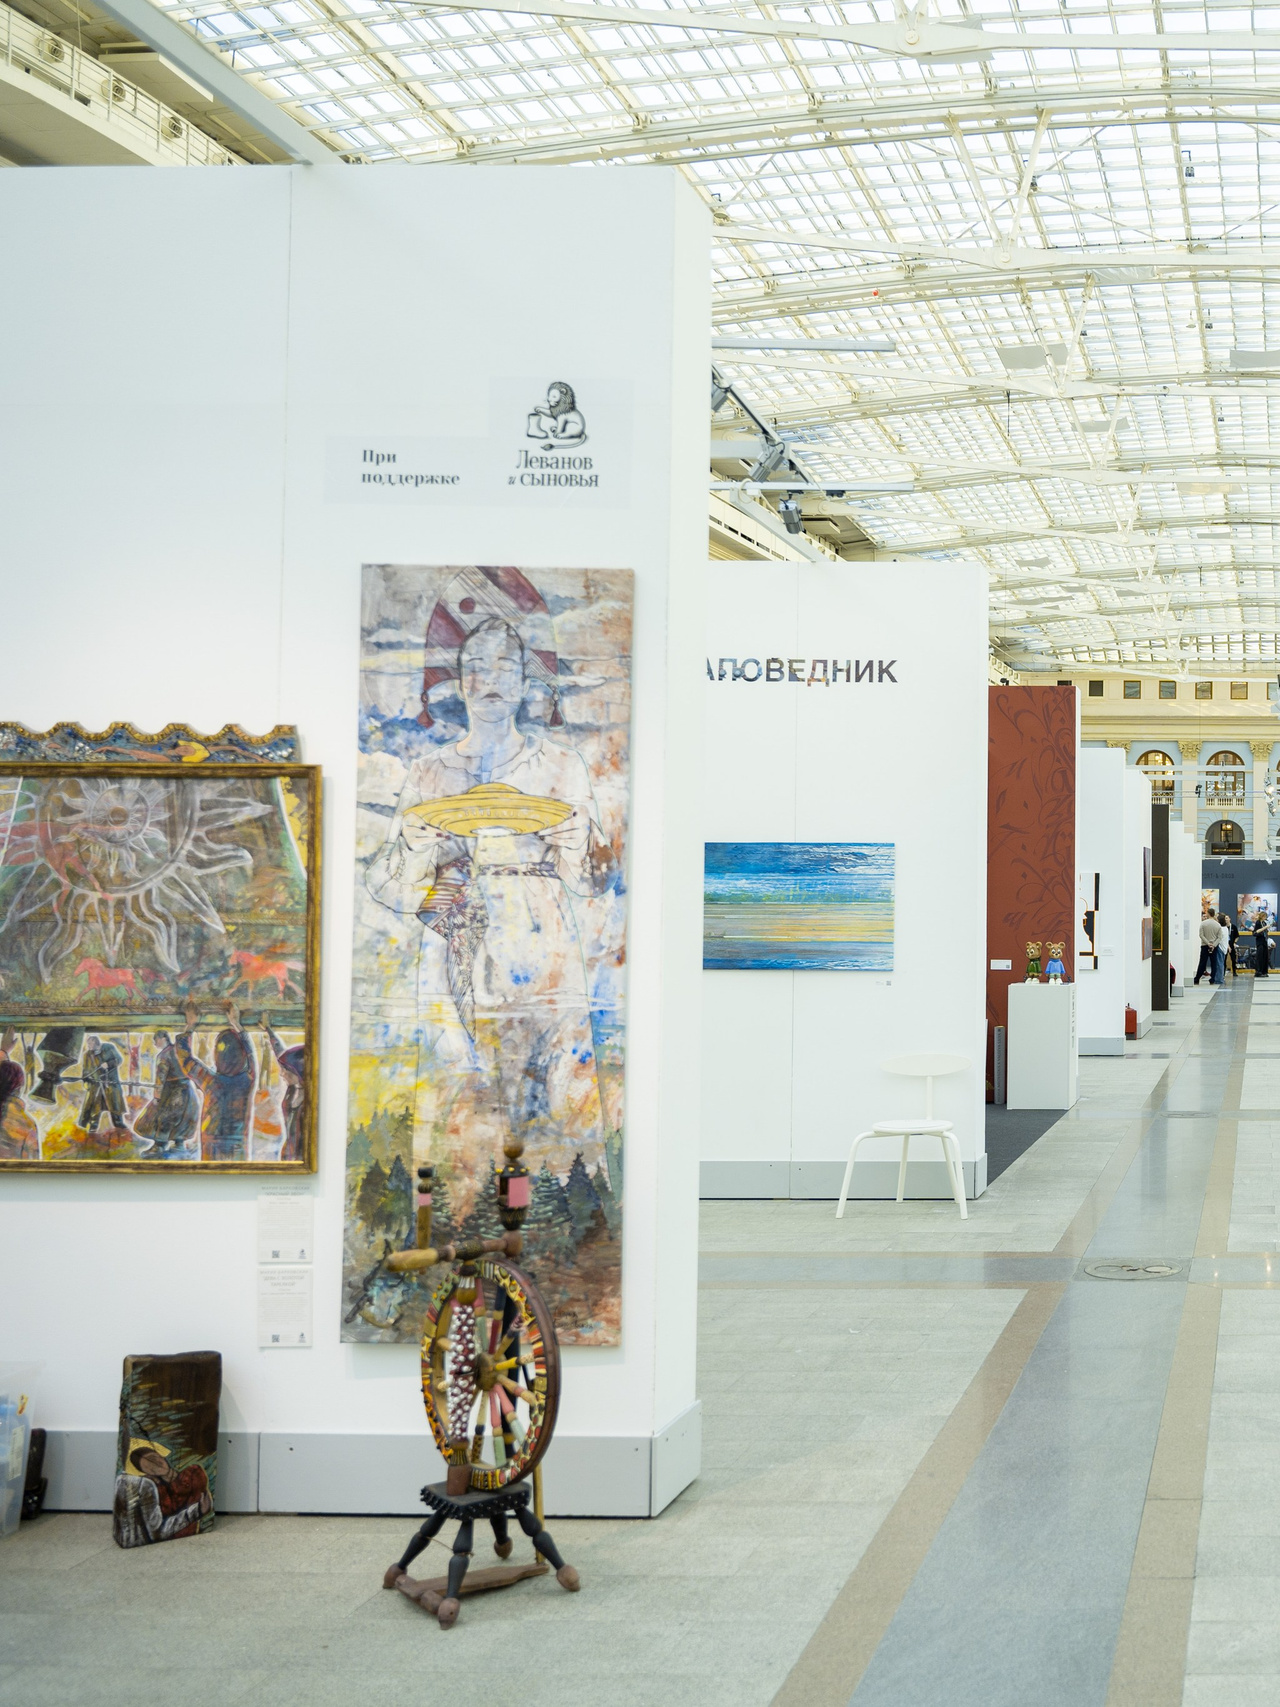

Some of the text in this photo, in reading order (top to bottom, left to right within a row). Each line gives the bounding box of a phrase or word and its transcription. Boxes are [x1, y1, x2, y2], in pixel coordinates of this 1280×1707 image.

[362, 449, 397, 466] При
[516, 449, 594, 471] Леванов
[361, 472, 461, 489] поддержке
[508, 472, 599, 488] и СЫНОВЬЯ
